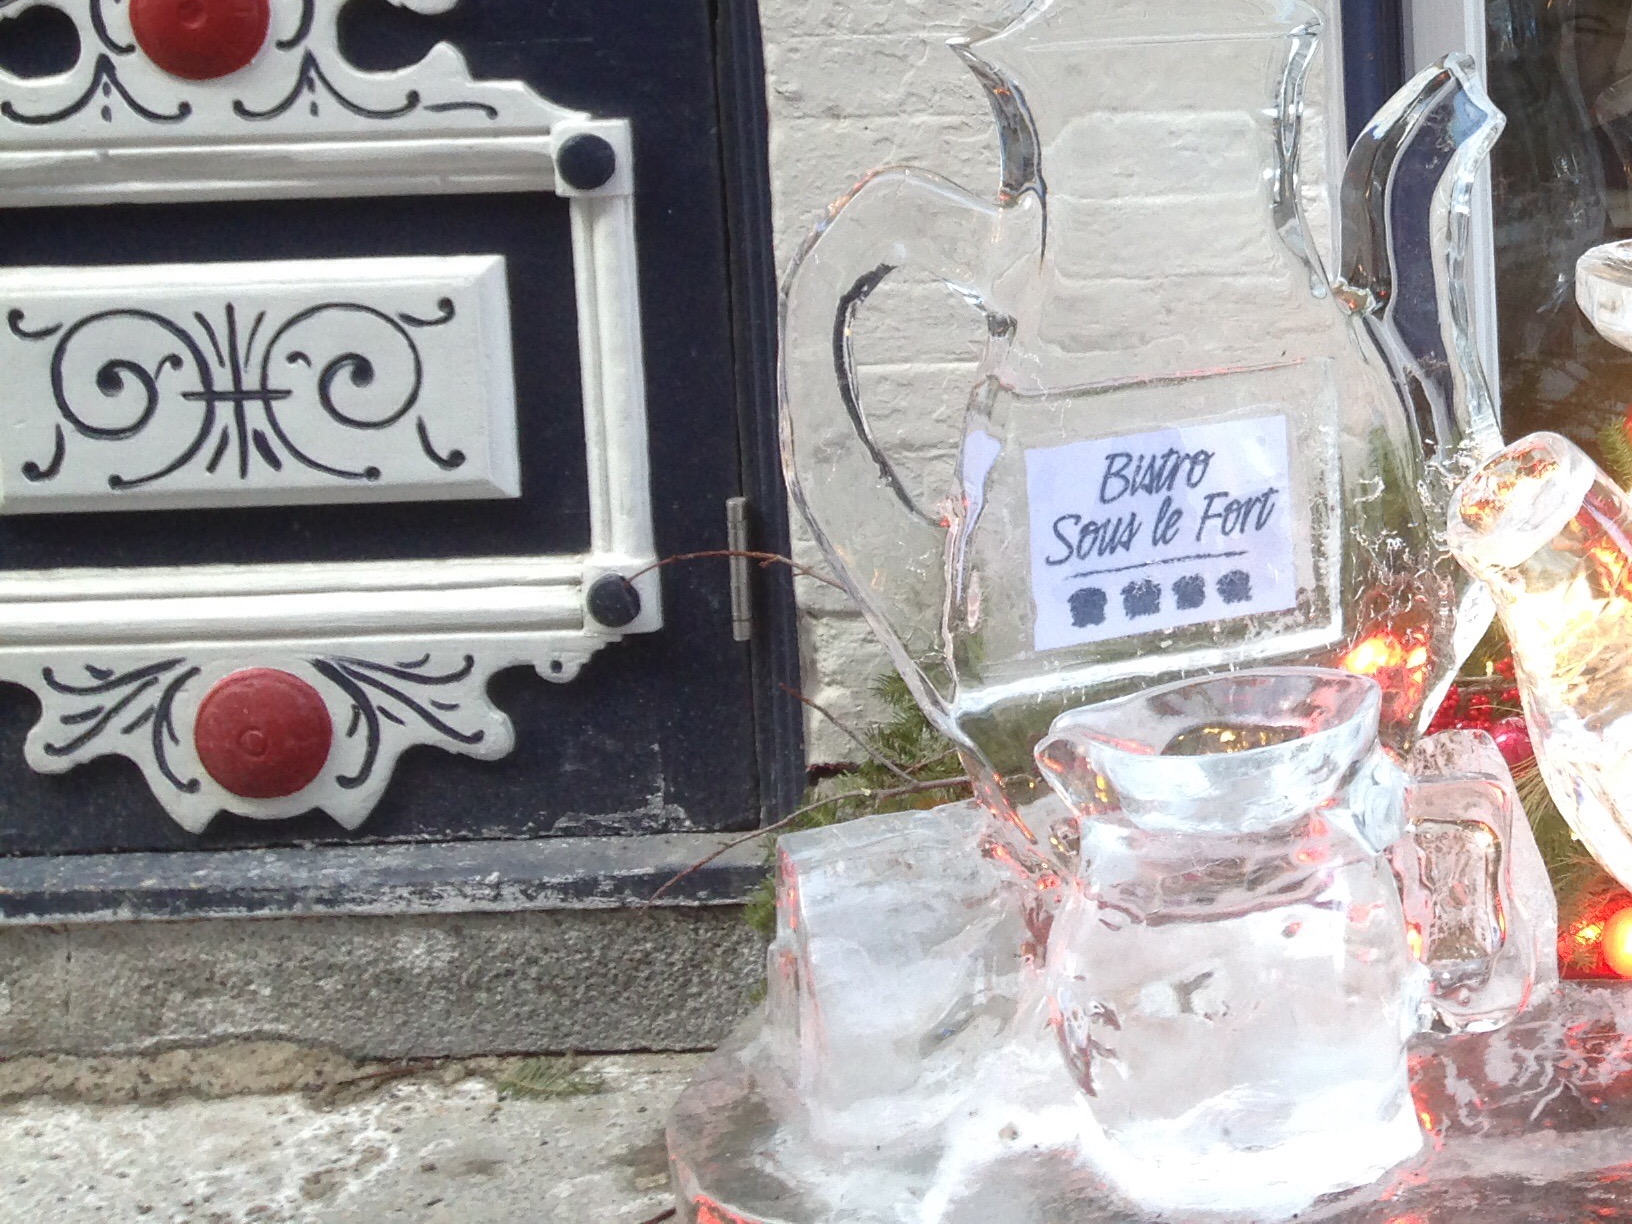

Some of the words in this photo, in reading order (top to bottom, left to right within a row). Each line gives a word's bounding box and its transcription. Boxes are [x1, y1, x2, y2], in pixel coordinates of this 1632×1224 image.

[1099, 447, 1215, 504] Bistro
[1045, 513, 1142, 566] Sous
[1151, 495, 1183, 547] le
[1195, 487, 1279, 542] Fort
